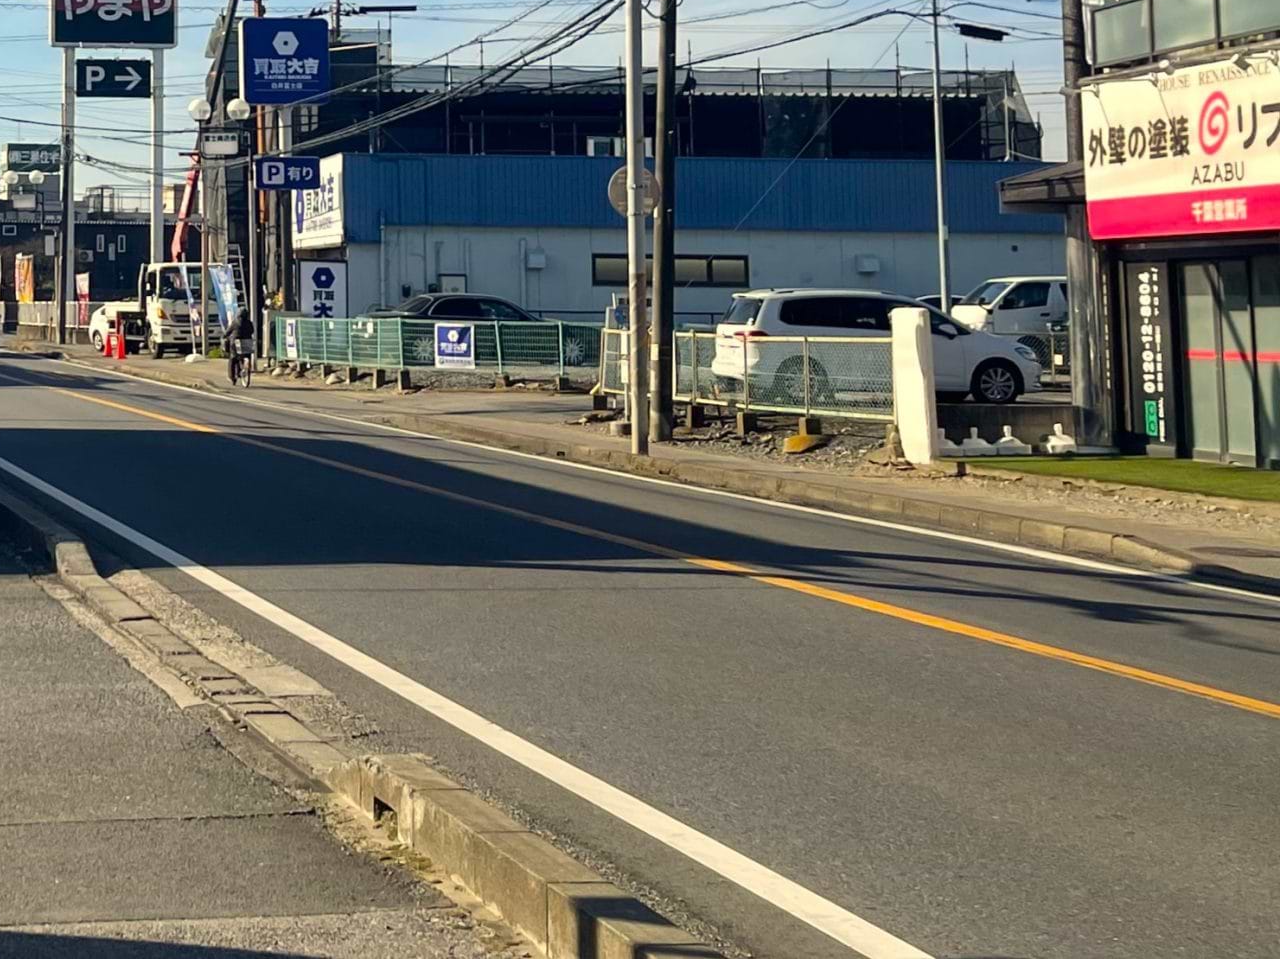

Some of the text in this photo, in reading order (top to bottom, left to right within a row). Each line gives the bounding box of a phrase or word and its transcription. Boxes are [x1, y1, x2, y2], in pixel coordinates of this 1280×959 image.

[253, 57, 320, 75] 買取大吉
[85, 65, 106, 90] P
[1159, 74, 1190, 92] HOUSE
[1088, 115, 1190, 168] 外壁の塗装
[270, 164, 313, 180] P 有り
[1191, 161, 1245, 185] AZABU
